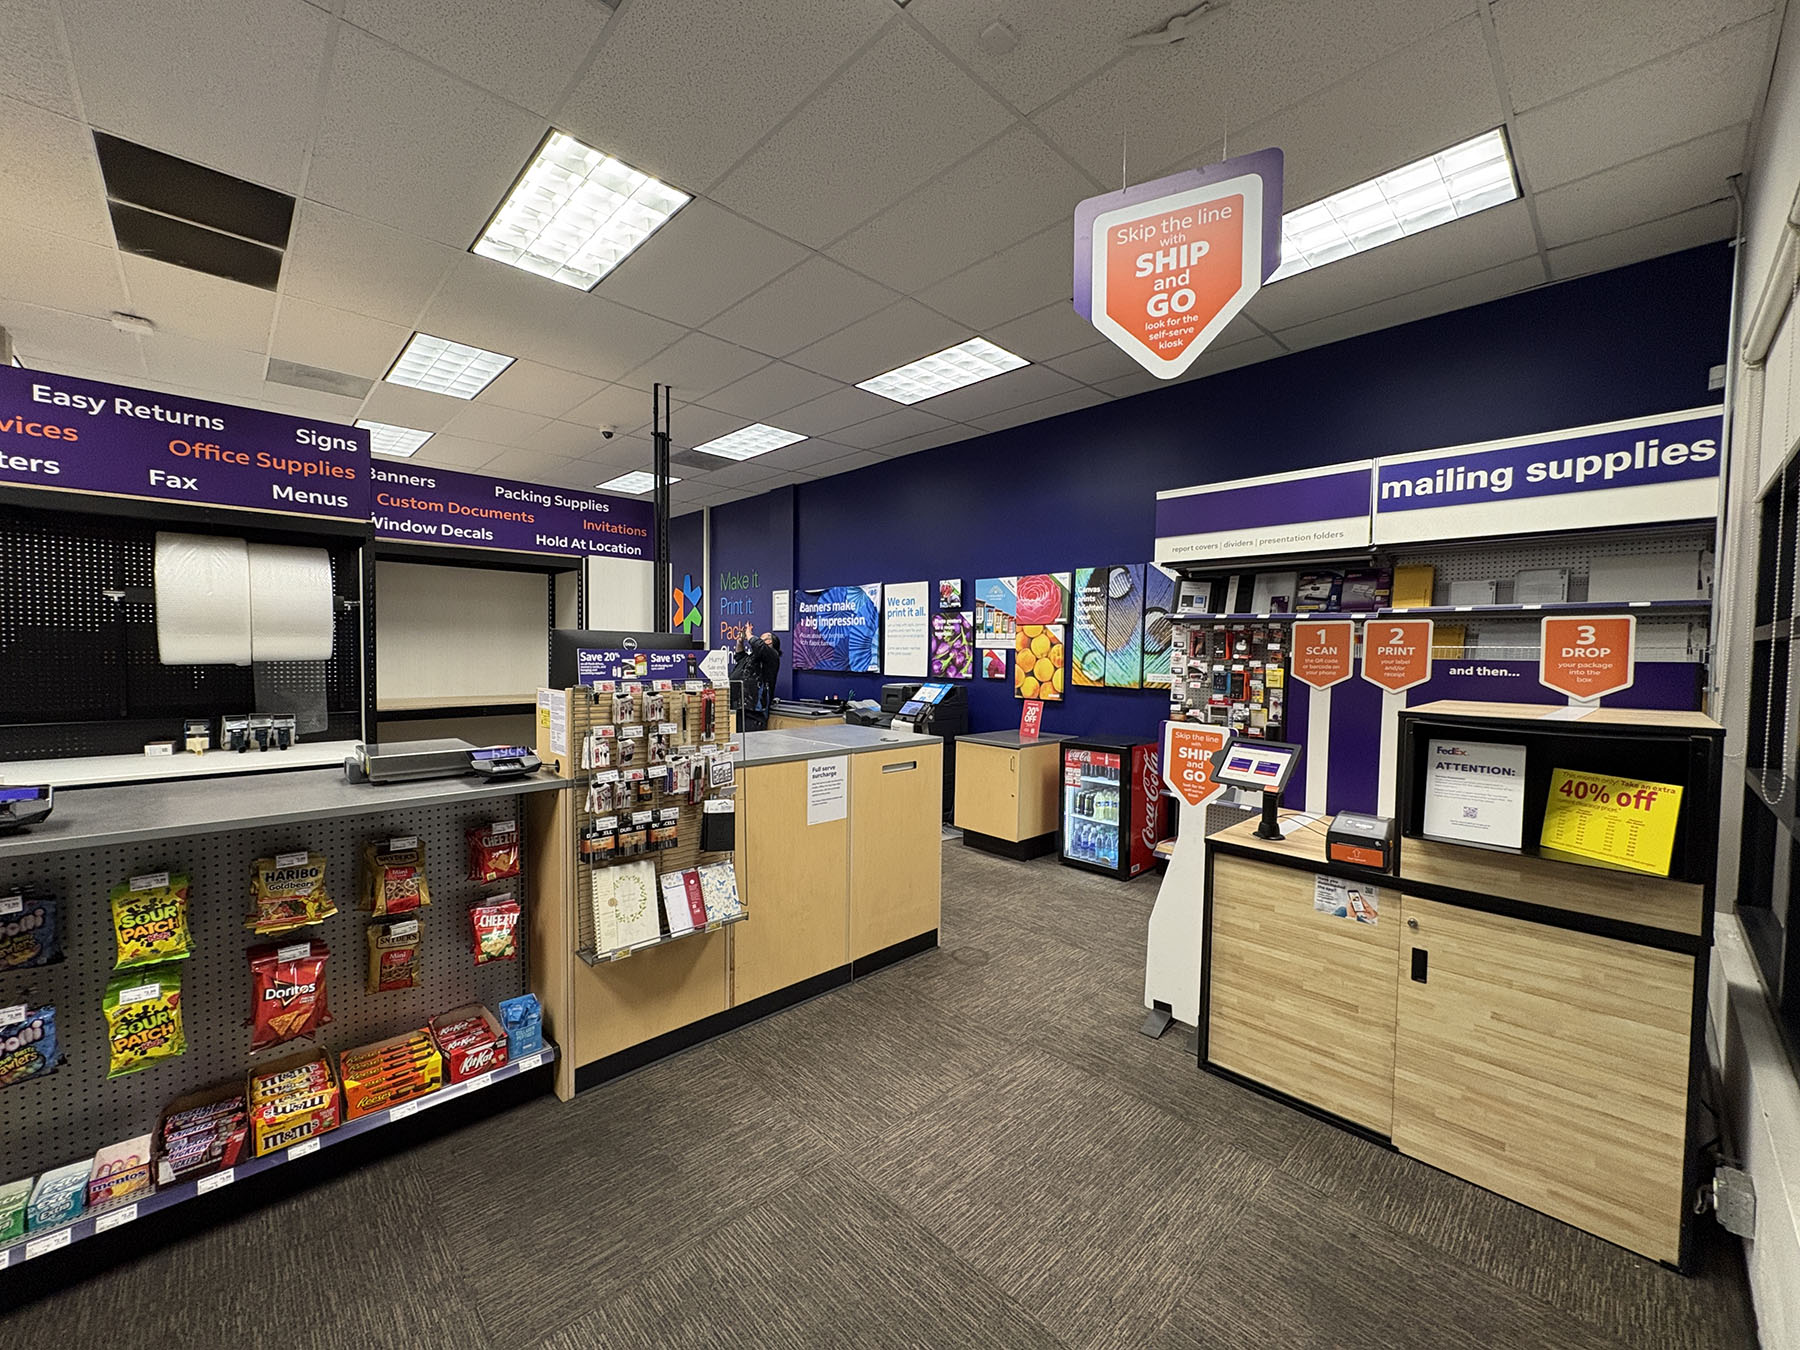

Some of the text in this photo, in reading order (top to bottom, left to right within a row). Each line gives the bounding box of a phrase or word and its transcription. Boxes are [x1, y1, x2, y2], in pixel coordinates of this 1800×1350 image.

[1116, 205, 1233, 246] Skip the line
[1159, 234, 1186, 247] with
[1135, 240, 1210, 278] SHIP
[1153, 269, 1190, 291] and
[1146, 288, 1197, 318] GO
[1145, 313, 1199, 331] look for the
[1148, 325, 1195, 341] self-serve
[1158, 338, 1184, 350] kiosk
[32, 383, 225, 431] Easy Returns
[295, 428, 358, 453] Signs
[168, 439, 356, 481] Office Supplies
[1381, 436, 1717, 500] mailing supplies
[149, 469, 199, 491] Fax
[272, 484, 349, 508] Menus
[495, 486, 609, 512] Packing Supplies
[377, 493, 535, 523] Custom Documents
[440, 523, 494, 541] Decals
[583, 519, 647, 537] Invitations
[536, 534, 642, 556] Hold At Location
[1172, 531, 1344, 554] report covers dividers presentation folders
[720, 571, 749, 591] Make
[720, 596, 744, 616] Print
[800, 600, 856, 613] Banners make
[887, 597, 915, 607] We can
[887, 606, 926, 619] print it all.
[806, 615, 866, 630] big impression
[1316, 629, 1326, 645] 1
[1389, 627, 1405, 645] 2
[1576, 625, 1596, 645] 3
[580, 652, 620, 662] Save 20%
[651, 654, 685, 663] Save 15%
[1306, 646, 1338, 655] SCAN
[1377, 646, 1416, 656] PRINT
[1561, 647, 1611, 658] DROP
[1318, 669, 1337, 677] phone
[1449, 666, 1520, 677] and then...
[1577, 662, 1614, 670] package
[1024, 715, 1037, 723] OFF
[1026, 706, 1040, 716] 20%
[1175, 732, 1219, 743] Skip the line
[1178, 747, 1213, 760] SHIP
[1437, 746, 1467, 756] FedEx
[1186, 761, 1204, 769] and
[1436, 762, 1516, 776] ATTENTION:
[812, 771, 837, 779] surcharge
[1183, 769, 1206, 782] GO
[1621, 780, 1639, 789] Take
[1652, 785, 1676, 794] extra
[1559, 779, 1658, 812] 40% off
[265, 867, 319, 882] HARIBO
[269, 881, 315, 891] Goldbears
[121, 906, 177, 928] SOUR
[121, 917, 179, 943] PATCH
[265, 983, 316, 1000] Doritos
[116, 1011, 170, 1038] SOUR
[114, 1022, 174, 1051] PATCH
[92, 1169, 147, 1192] mentos
